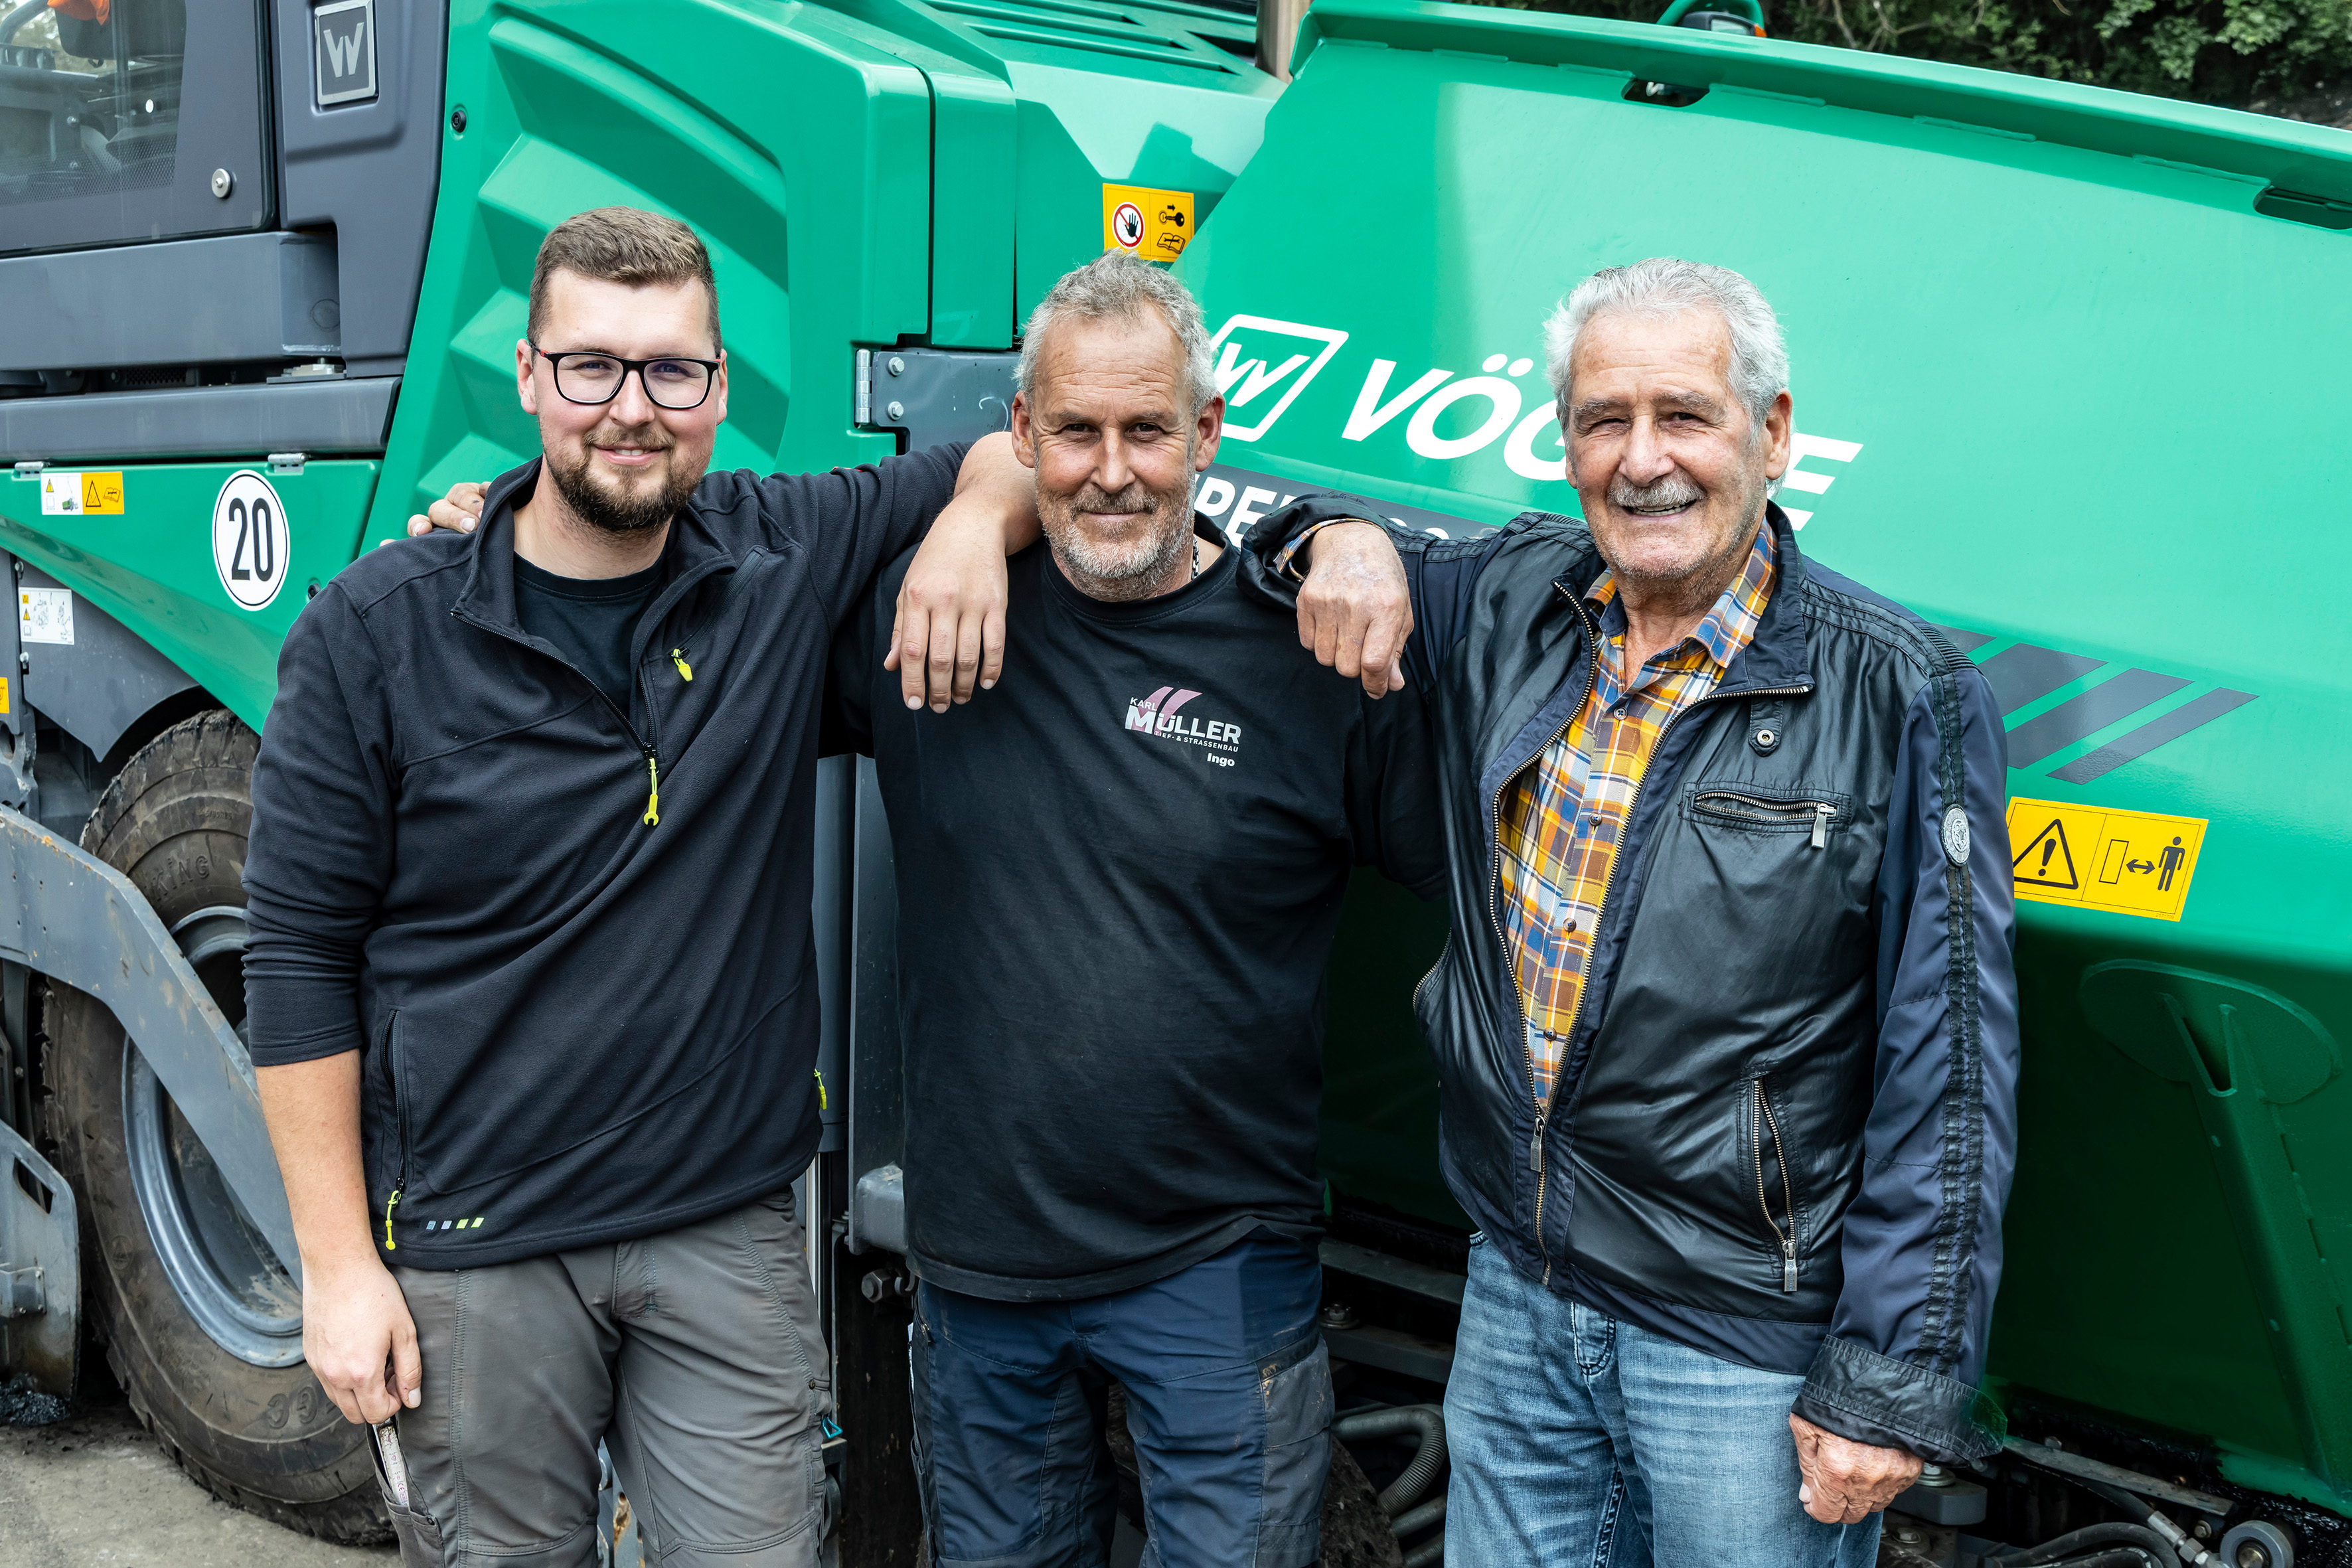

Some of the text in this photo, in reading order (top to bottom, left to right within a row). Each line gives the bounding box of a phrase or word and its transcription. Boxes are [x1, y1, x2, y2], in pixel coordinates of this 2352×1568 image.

[1342, 354, 1863, 531] VÖE
[1194, 473, 1298, 550] PE
[229, 497, 274, 582] 20
[1130, 697, 1157, 711] KARL
[1125, 705, 1241, 744] MÜLLER
[1184, 737, 1239, 752] STRASSENBAU
[1207, 753, 1235, 767] Ingo
